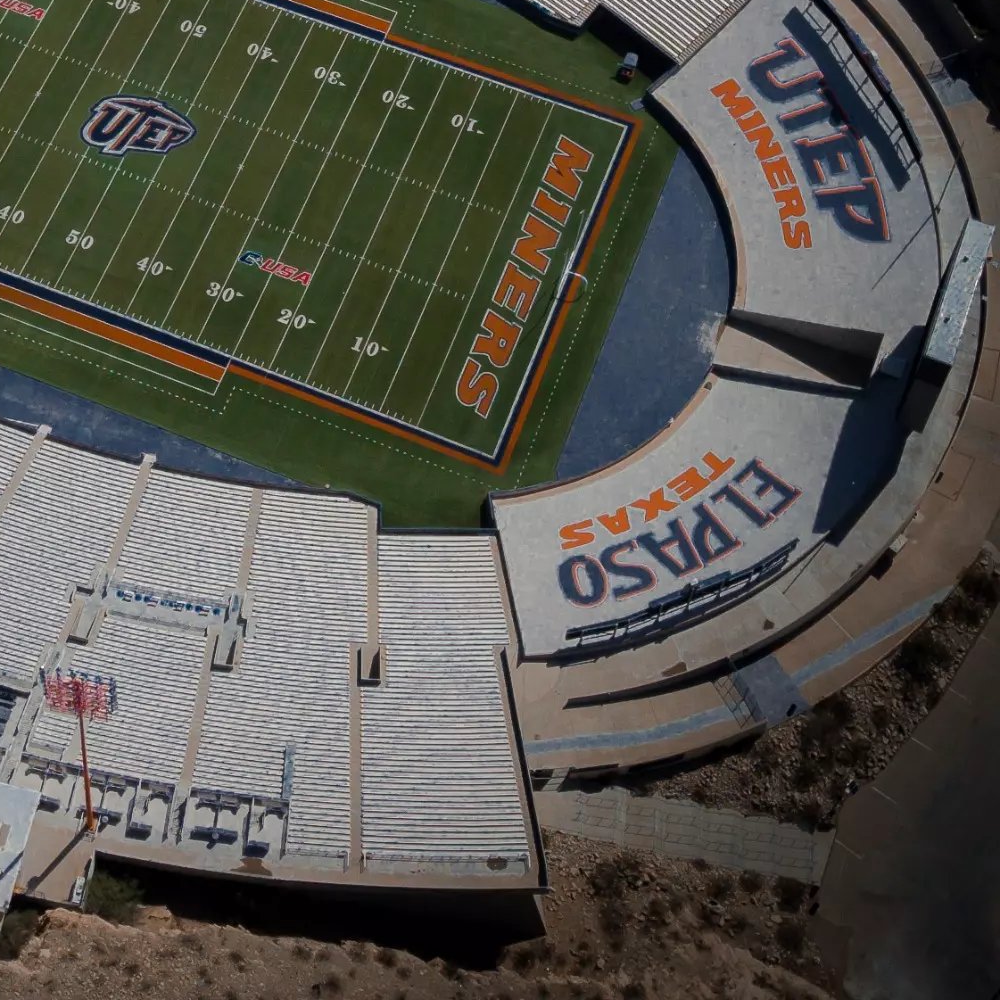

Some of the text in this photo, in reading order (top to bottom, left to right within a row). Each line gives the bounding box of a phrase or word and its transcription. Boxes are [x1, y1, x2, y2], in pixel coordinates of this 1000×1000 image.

[180, 19, 207, 37] 50
[247, 42, 273, 61] 40
[314, 66, 342, 86] 30
[382, 90, 409, 110] 20
[82, 95, 196, 156] UTEP
[451, 114, 479, 134] 10
[710, 77, 813, 250] MINERS
[65, 230, 94, 250] 50
[136, 256, 163, 276] 40
[455, 134, 594, 419] MINERS
[206, 281, 234, 302] 30
[277, 308, 306, 329] 20
[351, 335, 378, 356] 10
[558, 451, 736, 550] TEXAS
[557, 456, 803, 608] EL PASO
